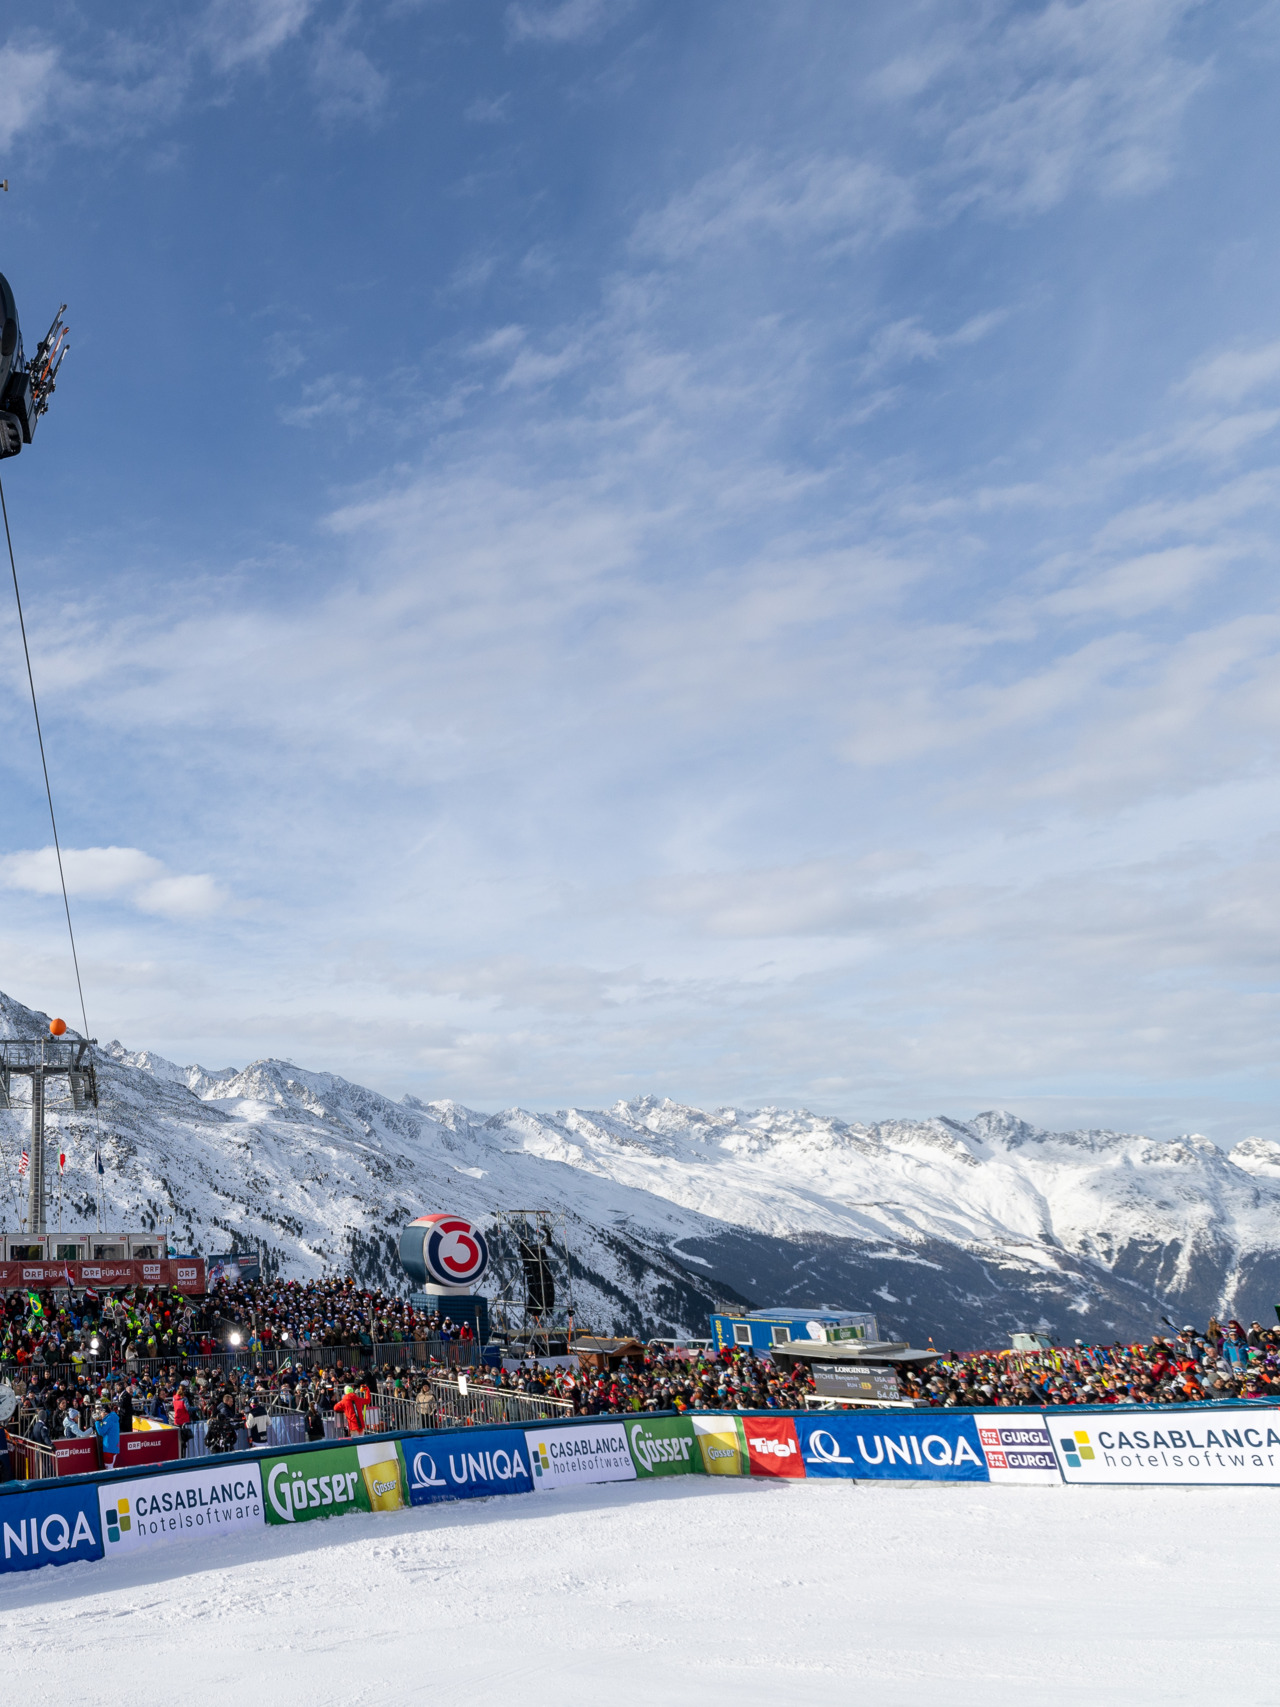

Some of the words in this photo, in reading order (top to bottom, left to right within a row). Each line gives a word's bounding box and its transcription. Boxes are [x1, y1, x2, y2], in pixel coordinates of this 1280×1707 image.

[25, 1270, 42, 1278] ORF
[84, 1269, 99, 1277] ORF
[101, 1267, 115, 1277] FÜR
[834, 1366, 870, 1374] LONGINES
[835, 1374, 860, 1382] Benjamin
[876, 1391, 900, 1400] 54.60
[981, 1429, 997, 1437] ÖTZ
[1001, 1431, 1048, 1444] GURGL
[1098, 1428, 1280, 1450] CASABLANCA
[550, 1437, 625, 1459] CASABLANCA
[631, 1424, 693, 1473] Gösser
[708, 1445, 734, 1461] Gösser
[856, 1435, 983, 1466] UNIQA
[448, 1449, 529, 1484] UNIQA
[553, 1452, 630, 1474] hotelsoftware
[988, 1452, 1004, 1460] ÖTZ
[1008, 1454, 1055, 1467] GURGL
[990, 1460, 1006, 1468] TAL
[268, 1462, 358, 1522] Gösser
[373, 1480, 397, 1497] Gösser
[136, 1479, 258, 1517] CASABLANCA
[137, 1503, 260, 1536] hotelsoftware
